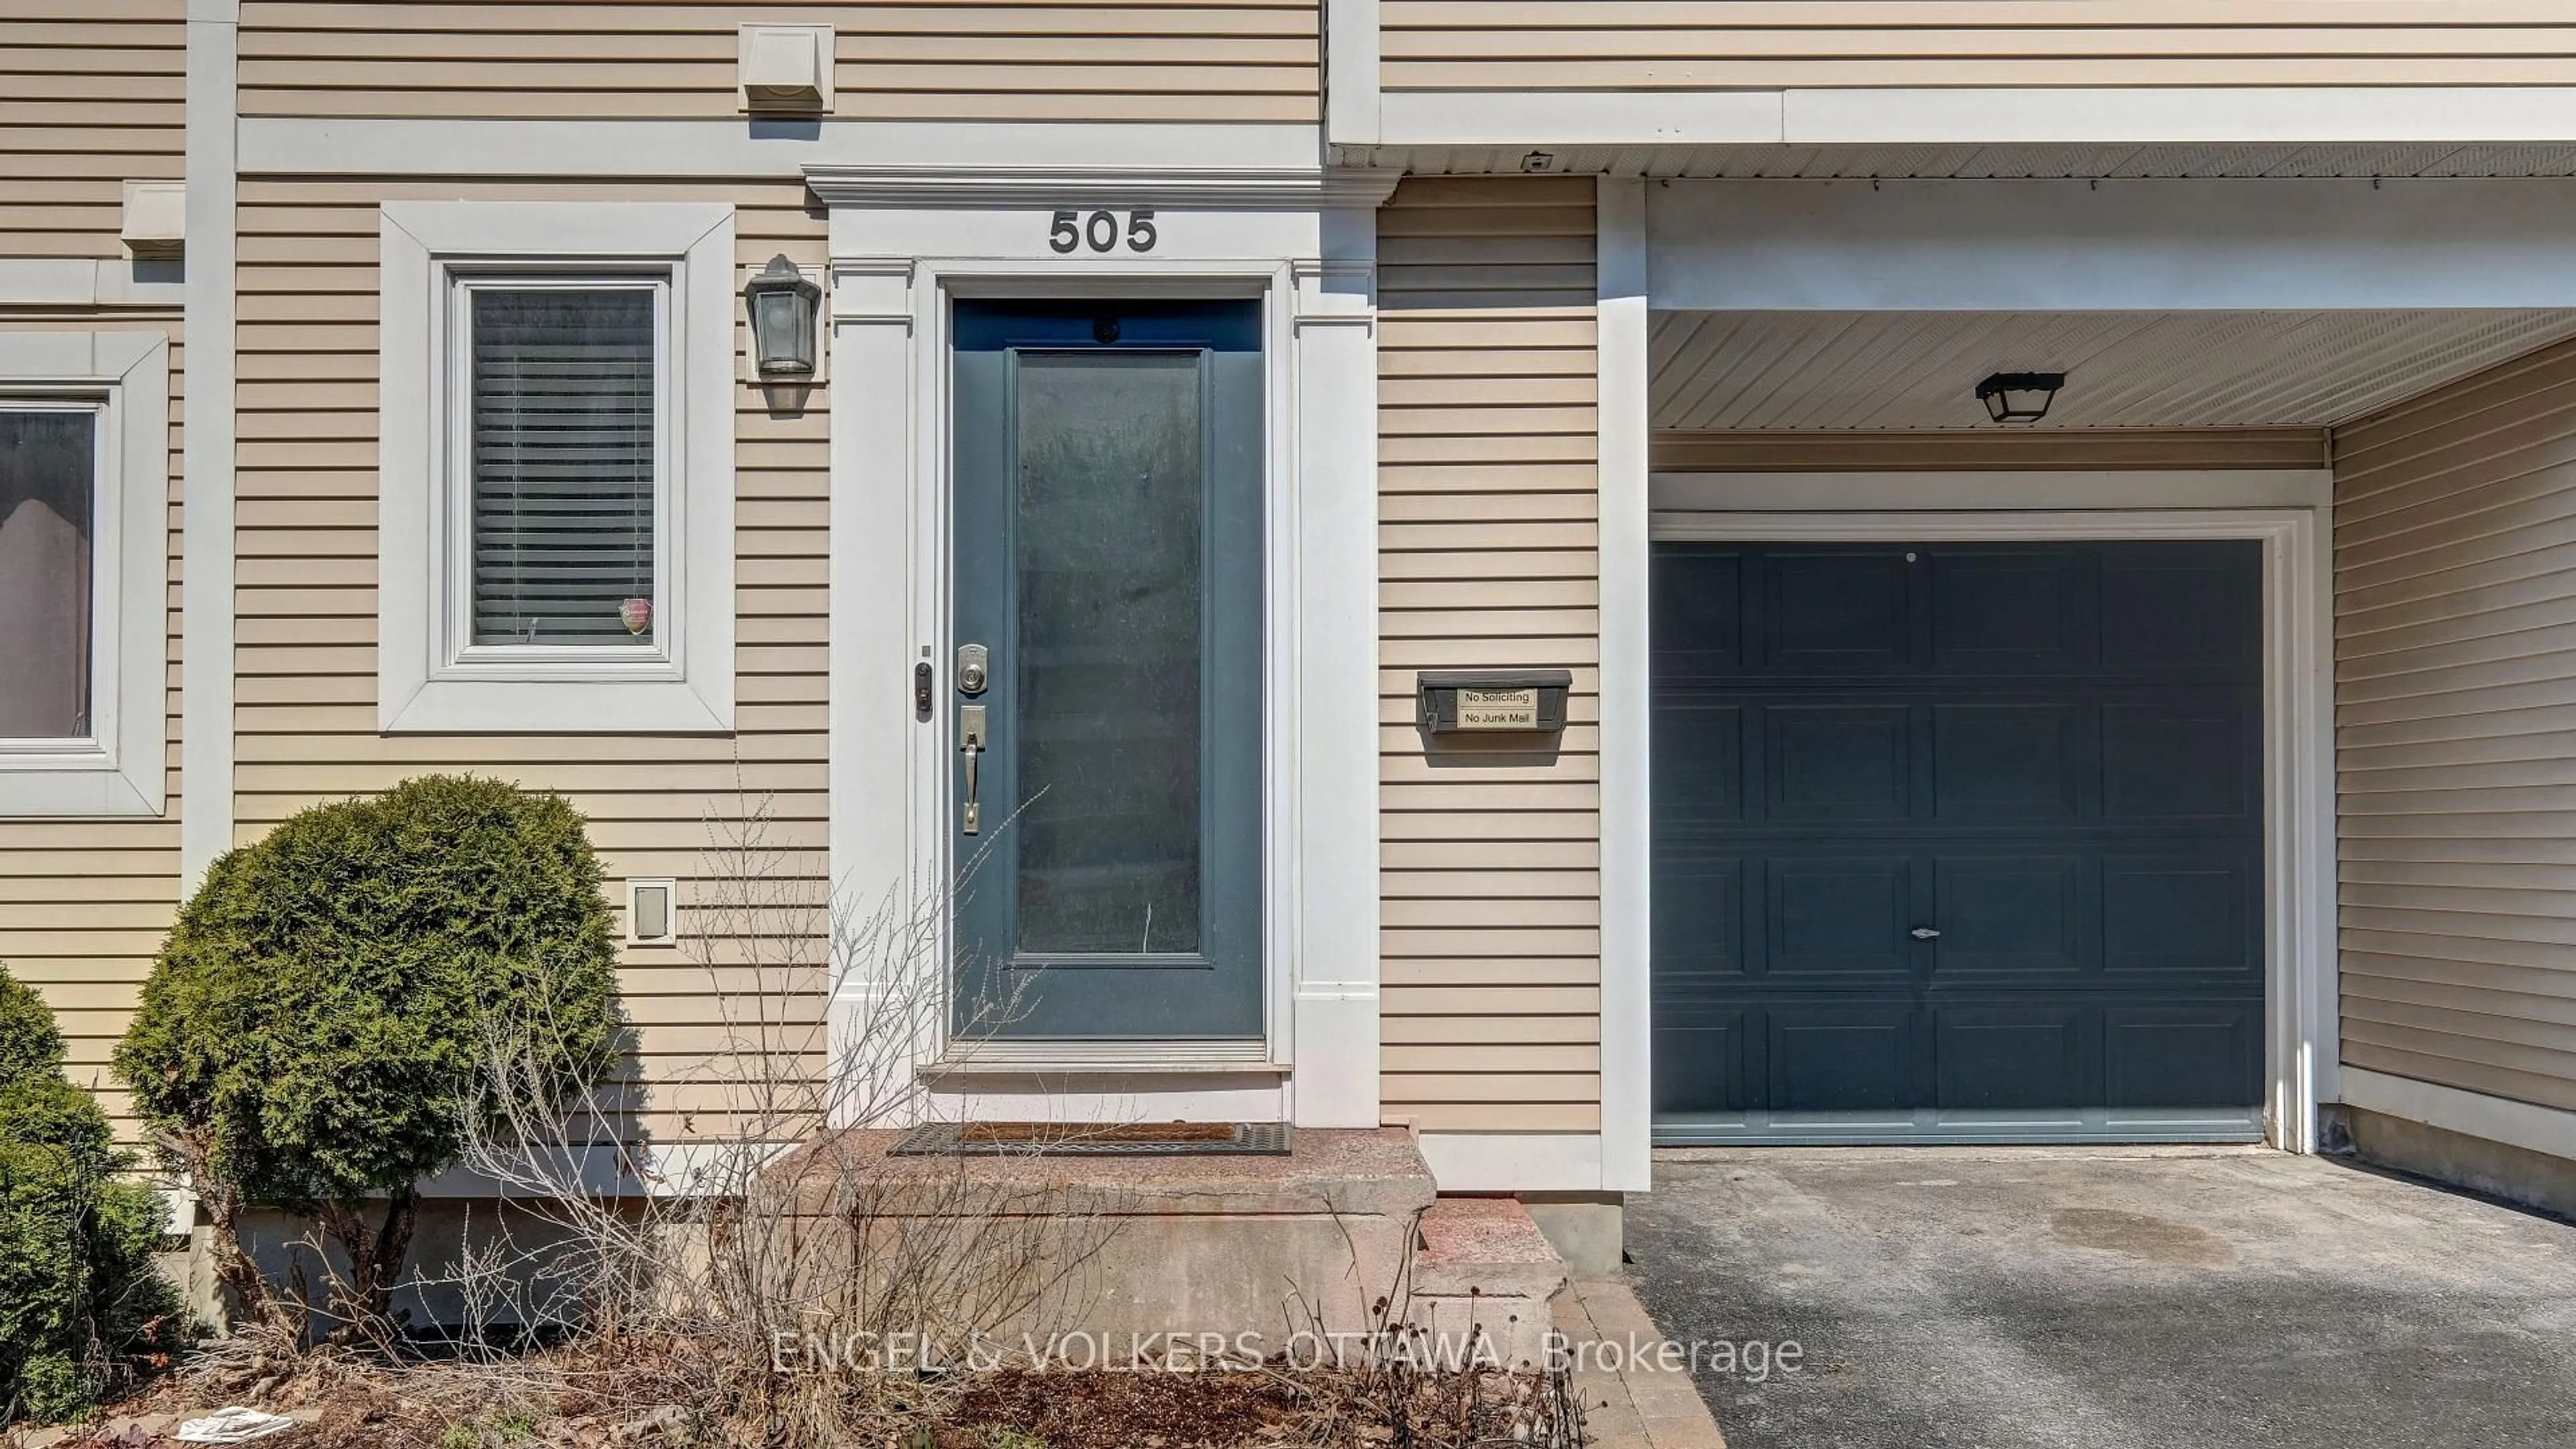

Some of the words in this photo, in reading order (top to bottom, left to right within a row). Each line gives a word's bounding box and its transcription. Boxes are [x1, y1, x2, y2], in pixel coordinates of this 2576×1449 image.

[1049, 210, 1157, 254] 505
[1465, 692, 1479, 702] No
[1483, 692, 1529, 704] Soliciting
[1465, 713, 1479, 723] No
[1483, 713, 1507, 723] Junk
[1509, 713, 1529, 723] Mail
